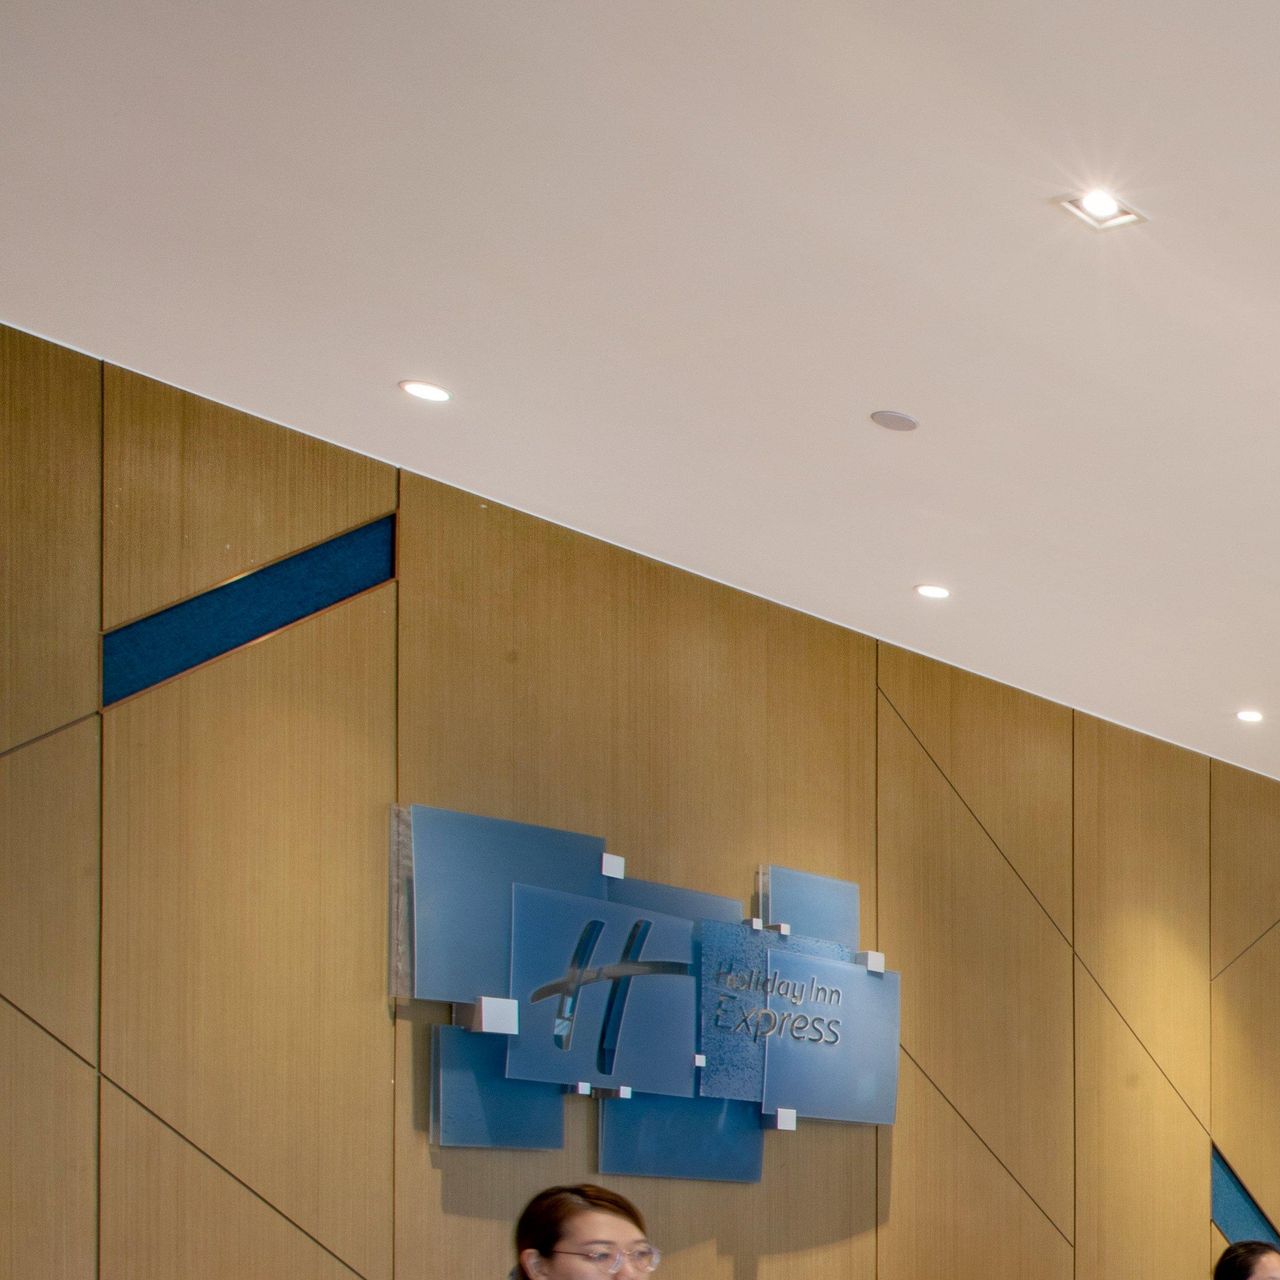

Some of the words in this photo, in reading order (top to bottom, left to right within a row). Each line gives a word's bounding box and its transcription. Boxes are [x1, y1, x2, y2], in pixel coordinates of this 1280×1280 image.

[715, 961, 806, 1006] Holiday
[810, 975, 842, 1006] Inn
[714, 992, 842, 1046] Express
